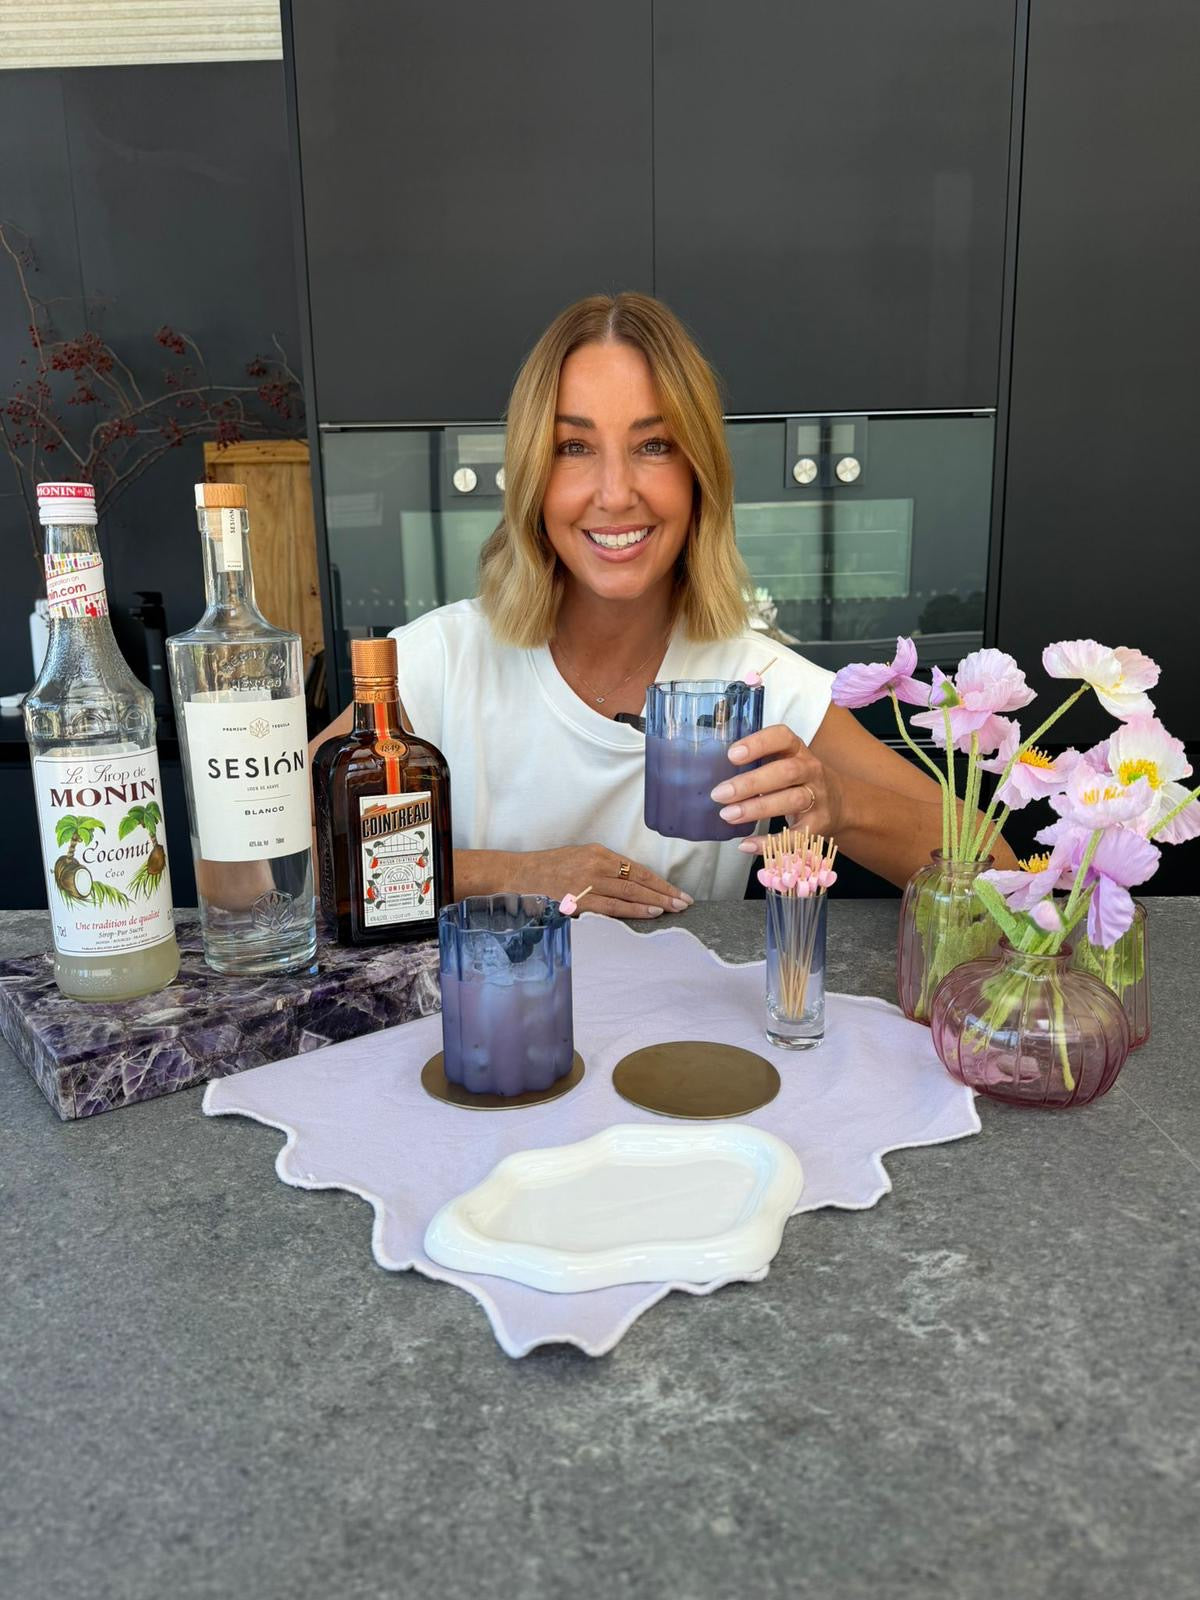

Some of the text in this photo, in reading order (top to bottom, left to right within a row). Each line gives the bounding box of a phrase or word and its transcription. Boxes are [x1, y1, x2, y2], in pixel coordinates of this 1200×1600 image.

[381, 744, 401, 753] 1849
[60, 763, 147, 785] Le Sirop de
[50, 777, 157, 808] MONIN
[244, 805, 285, 816] BLANCO
[362, 800, 431, 839] COINTREAU
[82, 840, 151, 864] Coconut
[105, 868, 125, 879] Coco
[75, 922, 90, 931] Une
[92, 919, 127, 930] tradition
[128, 915, 137, 926] de
